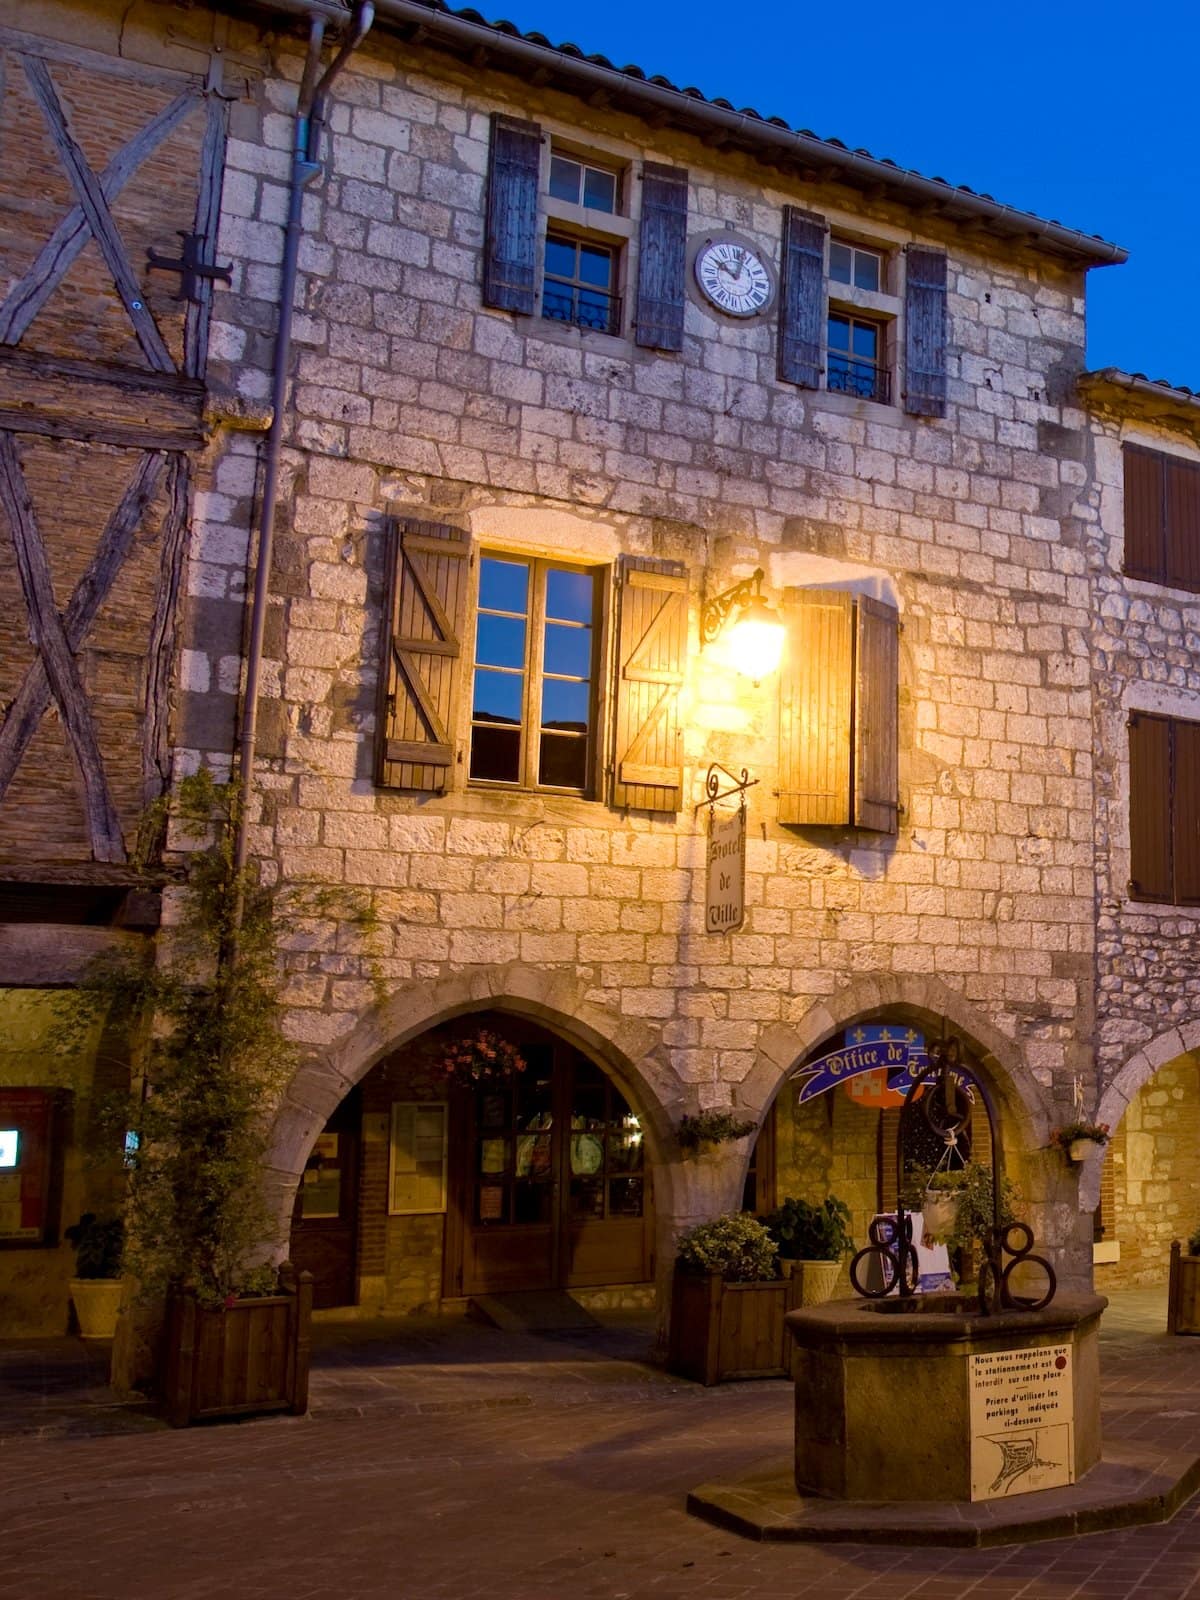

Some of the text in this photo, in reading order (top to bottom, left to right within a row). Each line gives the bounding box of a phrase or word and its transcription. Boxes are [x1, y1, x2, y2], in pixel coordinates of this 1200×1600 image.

[719, 872, 731, 891] de
[709, 904, 738, 925] Ville
[826, 1043, 902, 1075] Office de
[975, 1347, 1067, 1365] Nous vous rappelons que
[975, 1366, 982, 1376] le
[1041, 1360, 1052, 1369] est
[975, 1378, 1003, 1388] interdit
[1008, 1376, 1020, 1384] sur
[1022, 1373, 1040, 1383] cette
[1011, 1393, 1045, 1402] d'utiliser
[1047, 1389, 1059, 1398] les
[986, 1407, 1018, 1419] parkings
[1004, 1417, 1041, 1427] ci-dessous
